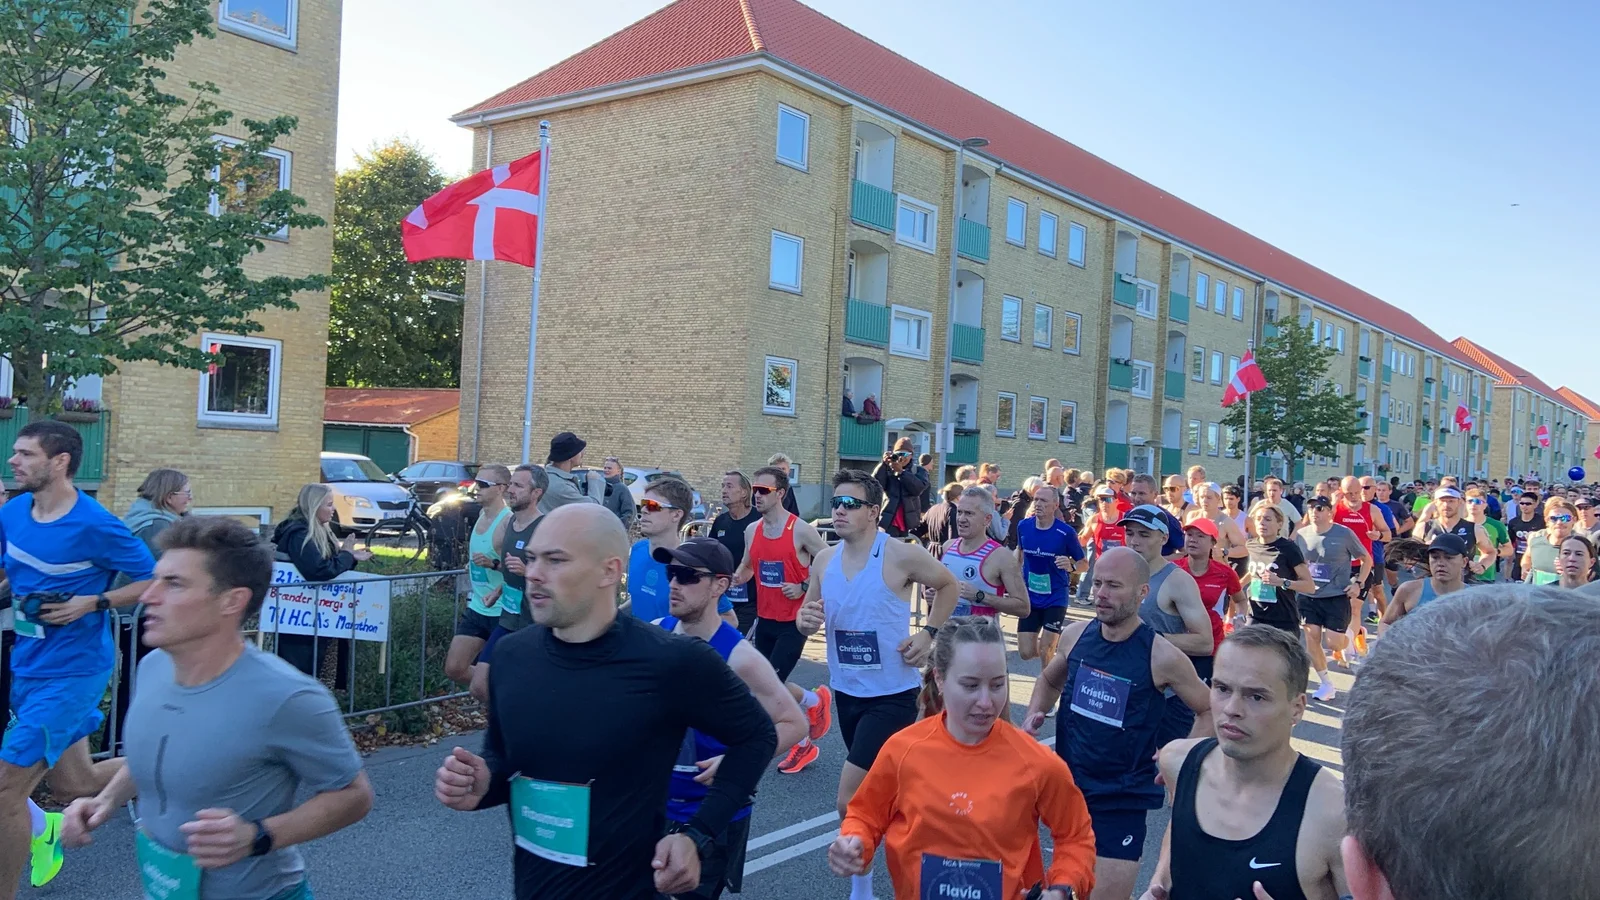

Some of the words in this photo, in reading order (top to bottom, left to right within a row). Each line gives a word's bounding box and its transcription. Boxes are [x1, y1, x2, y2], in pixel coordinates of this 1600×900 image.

[270, 587, 312, 606] Bænder
[839, 645, 872, 653] Christian
[1080, 684, 1116, 704] Kristian
[939, 883, 982, 900] Flavia
